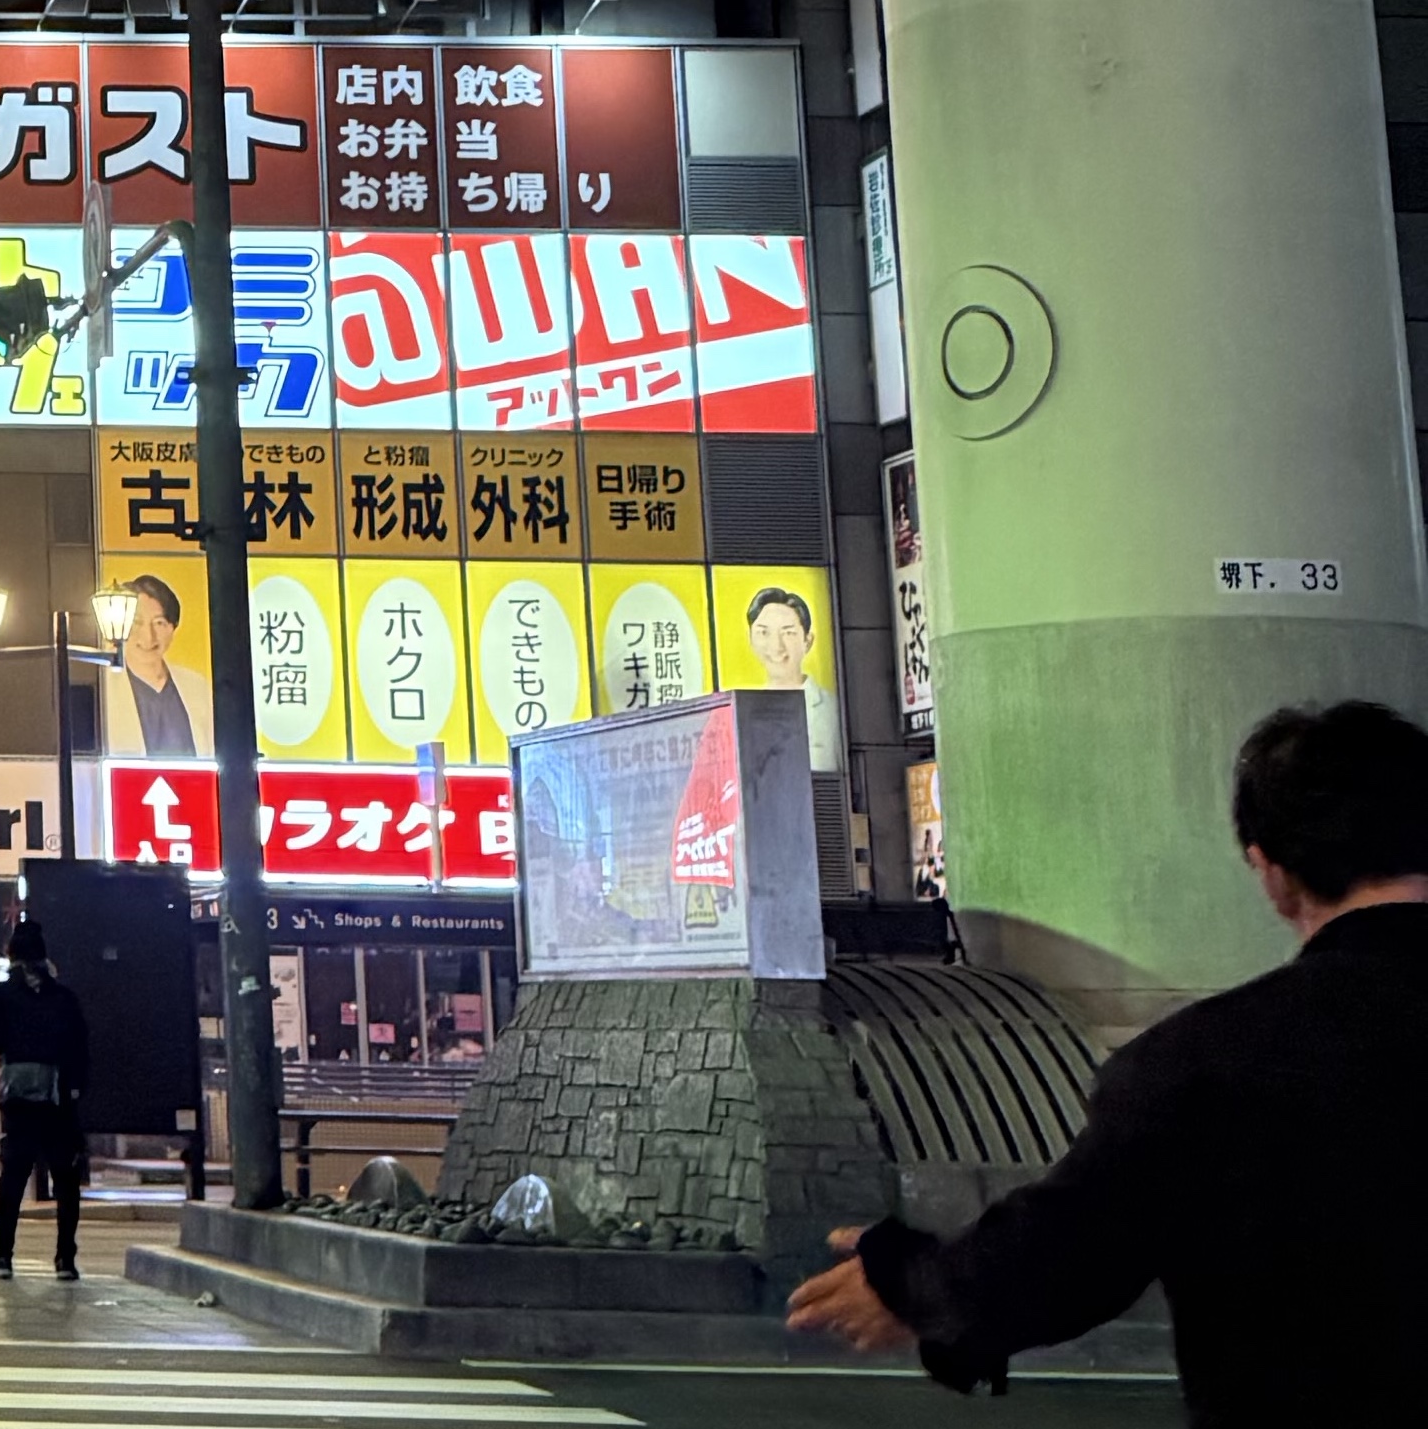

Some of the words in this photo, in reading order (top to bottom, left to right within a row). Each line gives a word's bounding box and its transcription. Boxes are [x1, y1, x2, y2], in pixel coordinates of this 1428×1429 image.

[336, 64, 544, 107] 店内飲食
[338, 118, 498, 160] お弁当
[340, 170, 612, 213] お持ち帰り
[597, 465, 685, 495] 日帰り
[609, 500, 677, 533] 手術
[1301, 563, 1339, 591] 33
[259, 609, 307, 706] 粉瘤
[383, 602, 426, 721] ホクロ
[509, 598, 547, 729] できもの
[622, 622, 651, 710] ワキガ
[333, 913, 382, 929] Shops
[411, 914, 505, 931] Restaurants
